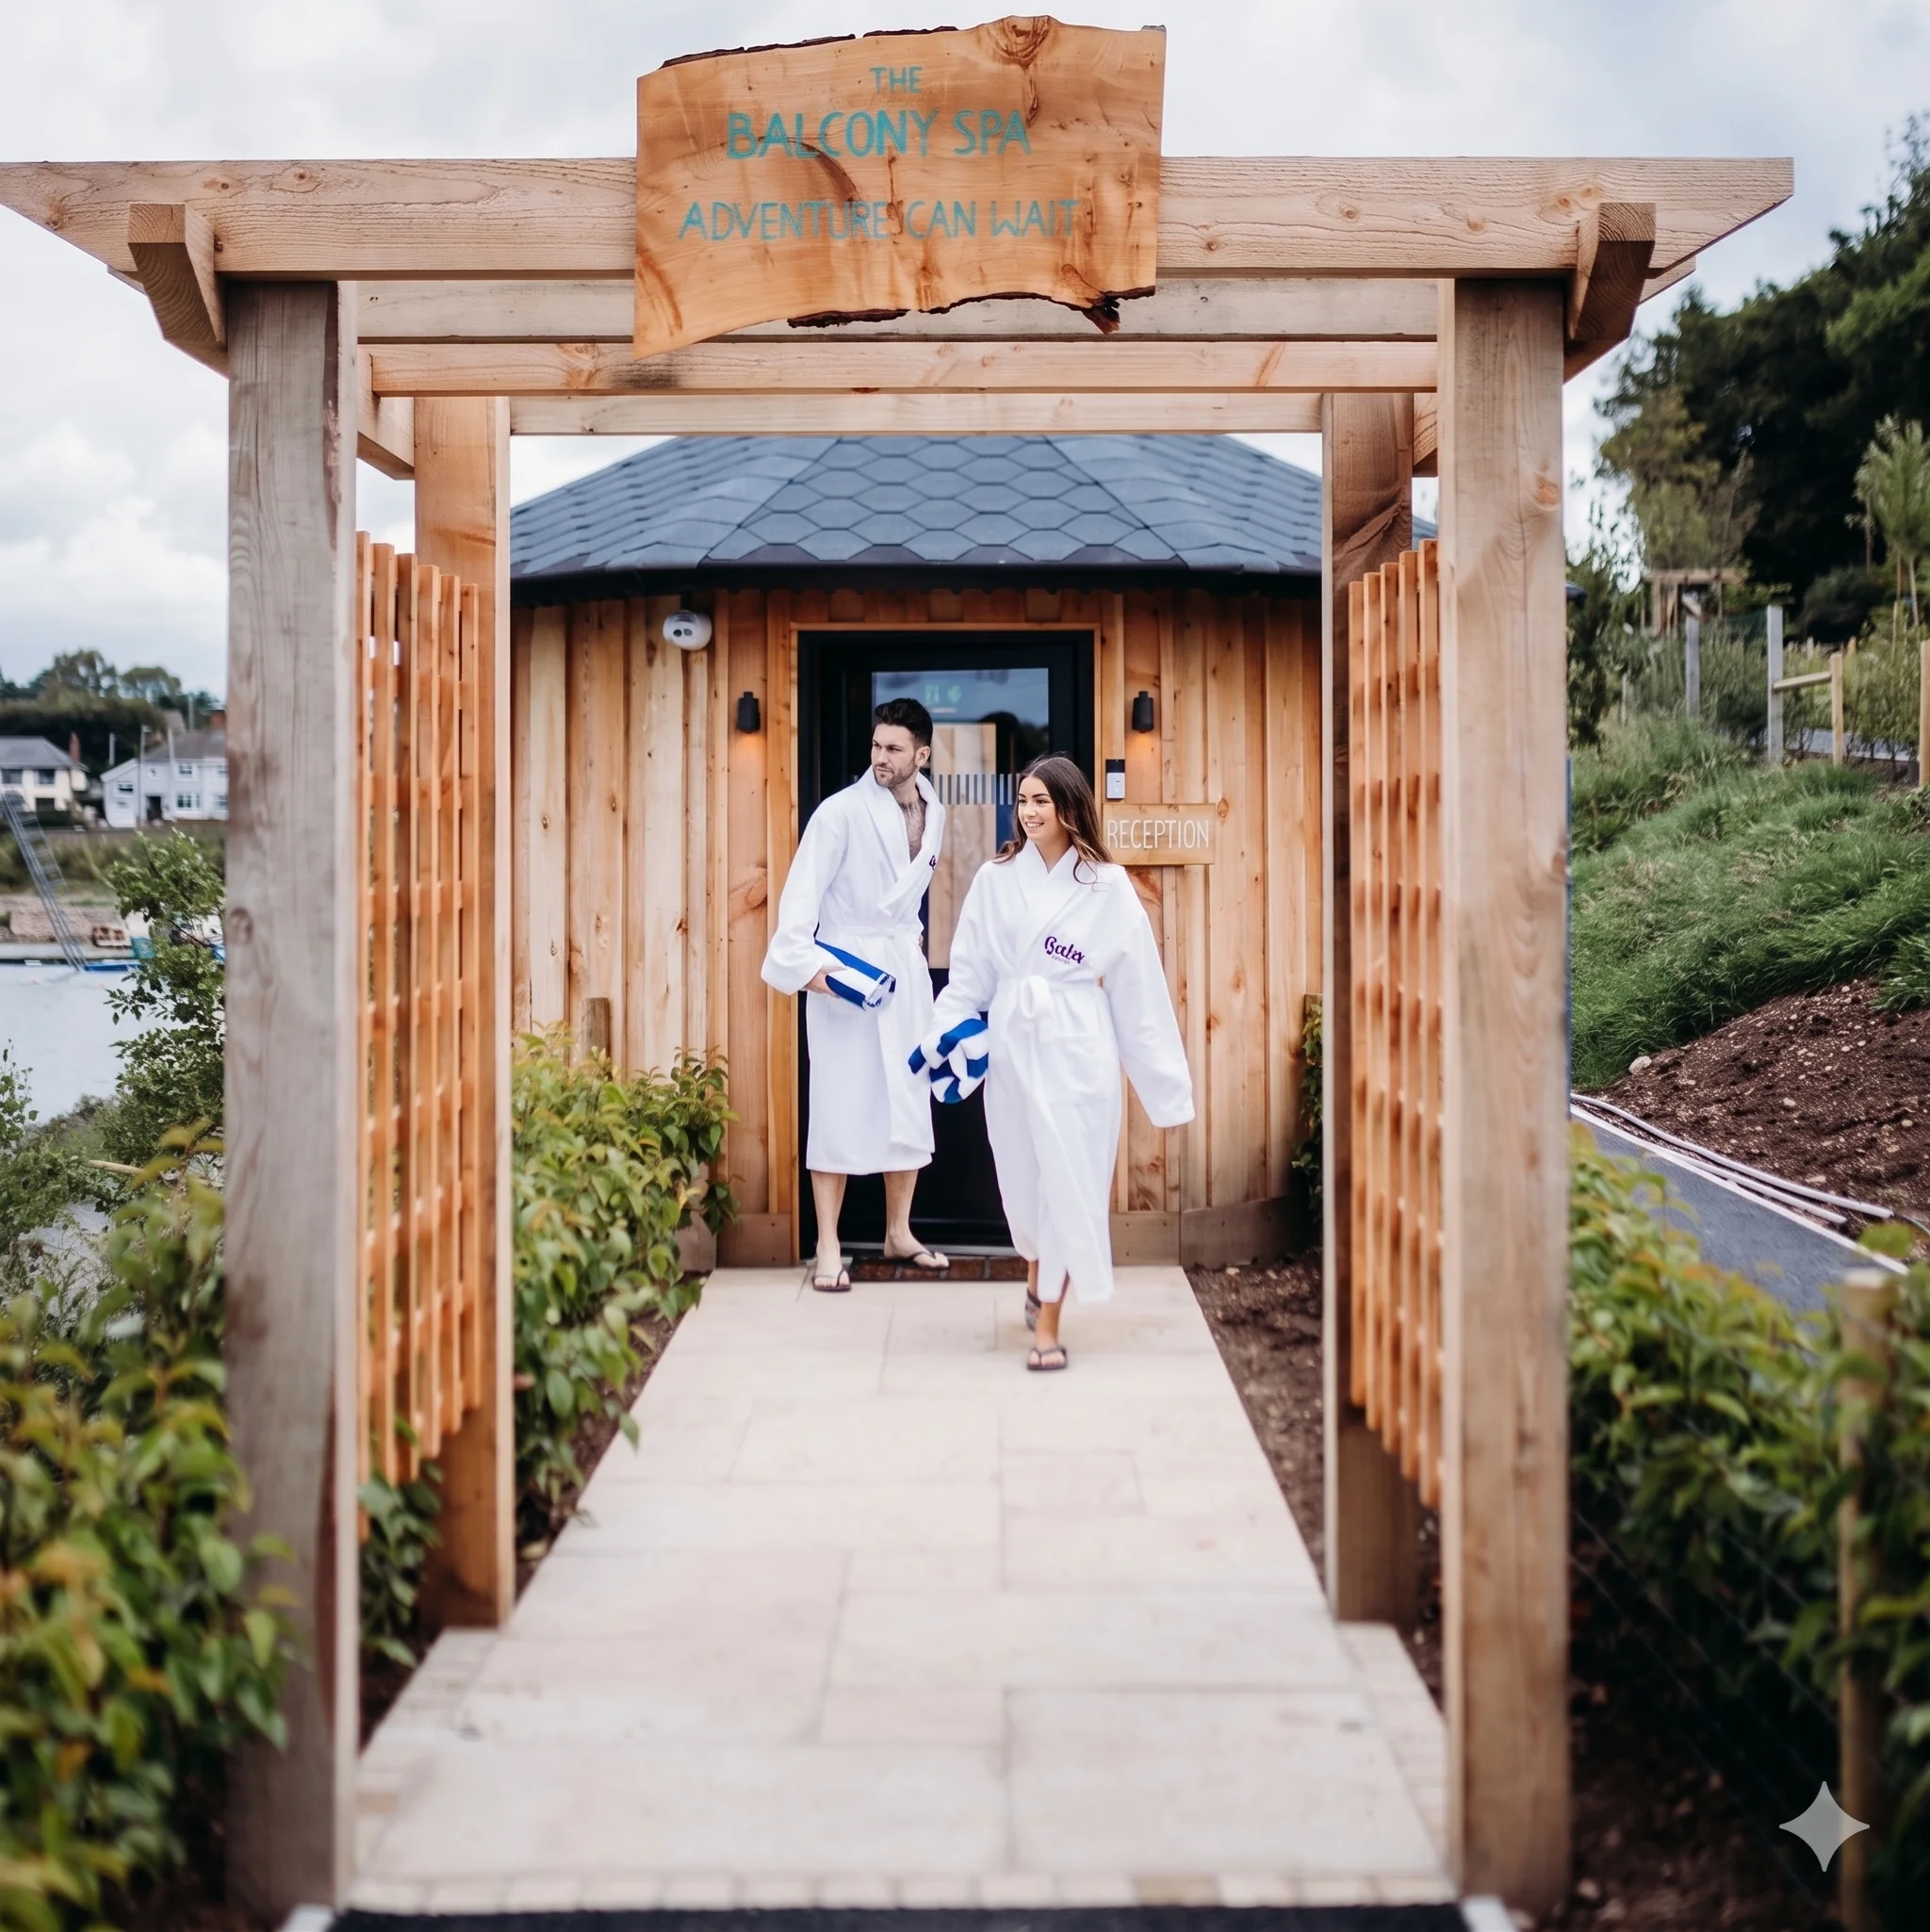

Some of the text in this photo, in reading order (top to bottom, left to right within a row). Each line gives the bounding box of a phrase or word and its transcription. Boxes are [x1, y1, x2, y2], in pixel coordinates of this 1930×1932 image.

[870, 66, 923, 93] THE
[728, 109, 1031, 159] BALCONY SPA
[679, 198, 1080, 240] ADVENTURE CAN WAIT
[1107, 819, 1209, 848] RECEPTION
